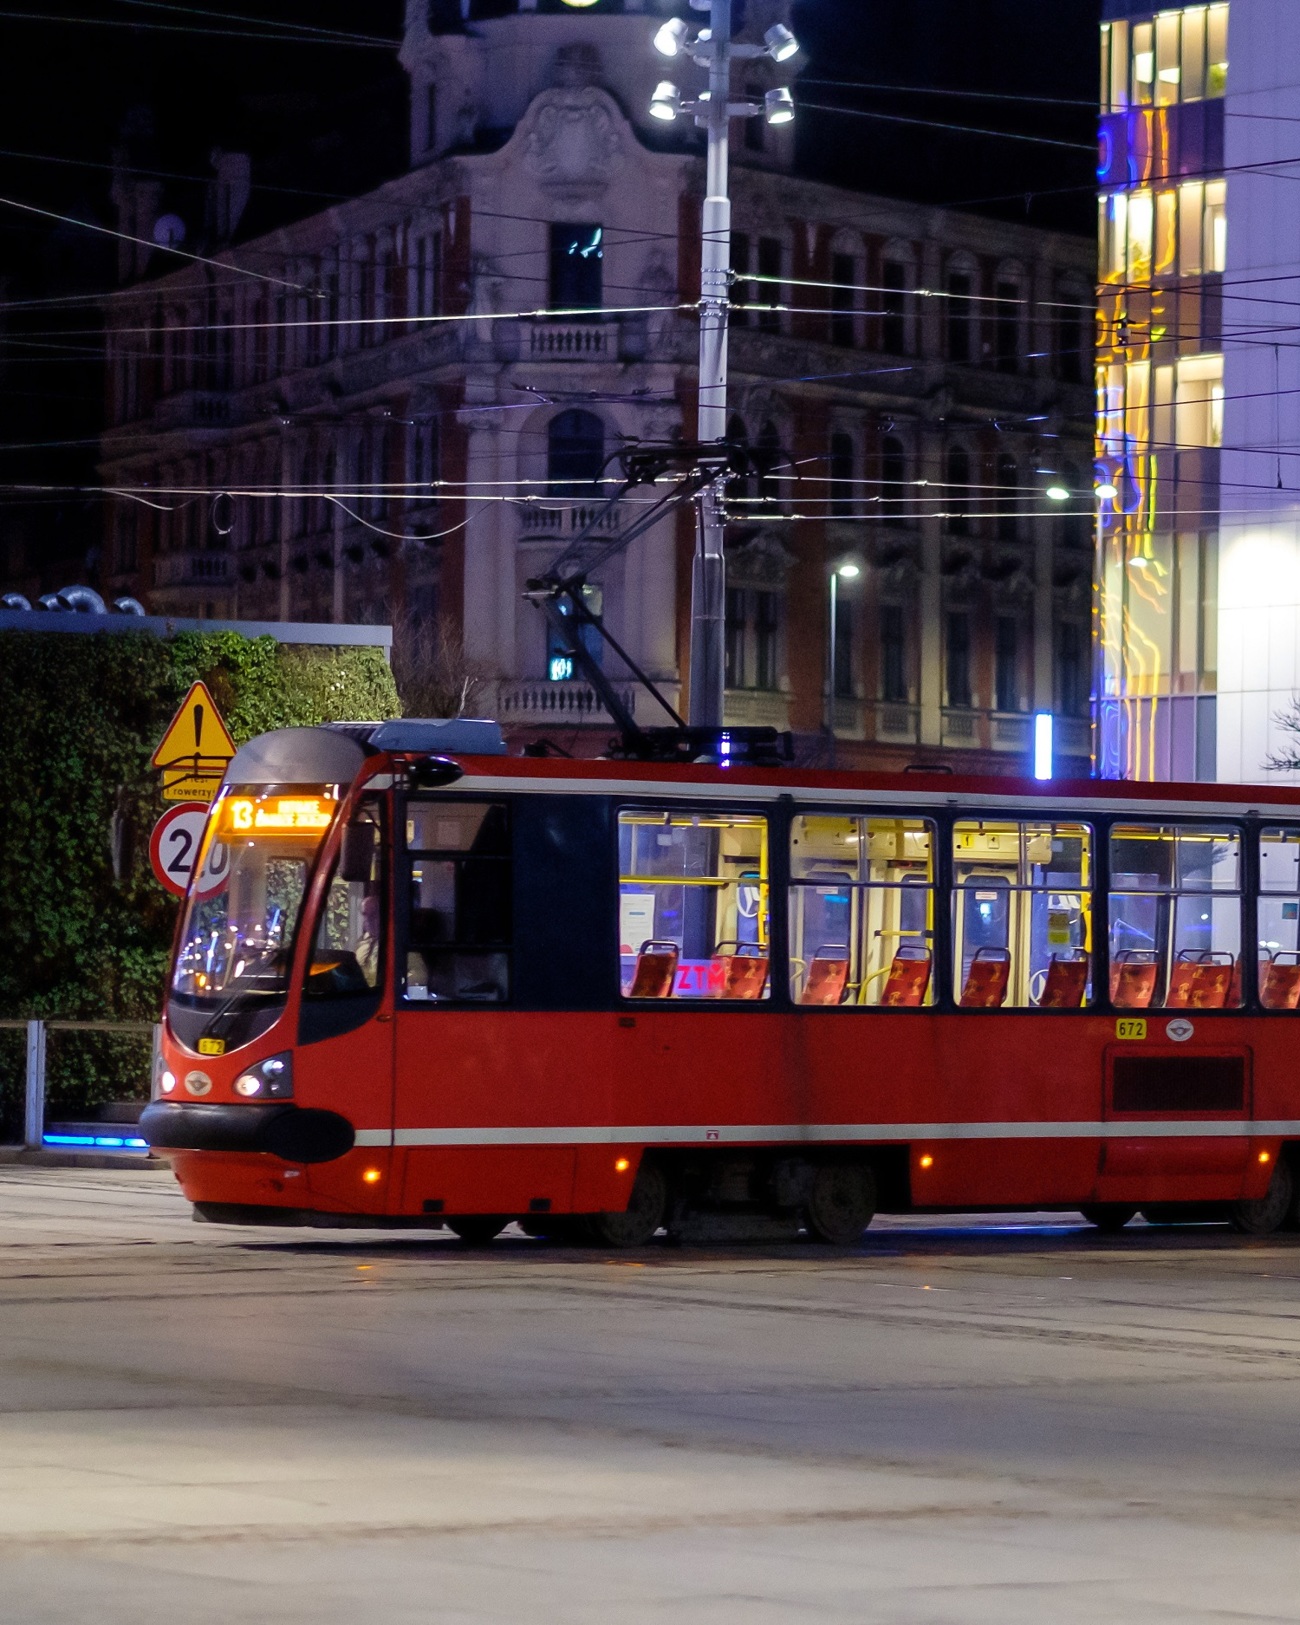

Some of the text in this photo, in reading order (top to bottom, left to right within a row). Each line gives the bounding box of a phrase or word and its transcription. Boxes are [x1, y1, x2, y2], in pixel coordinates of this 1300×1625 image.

[231, 800, 254, 829] 13
[677, 963, 726, 990] ZTM
[1119, 1022, 1143, 1036] 672
